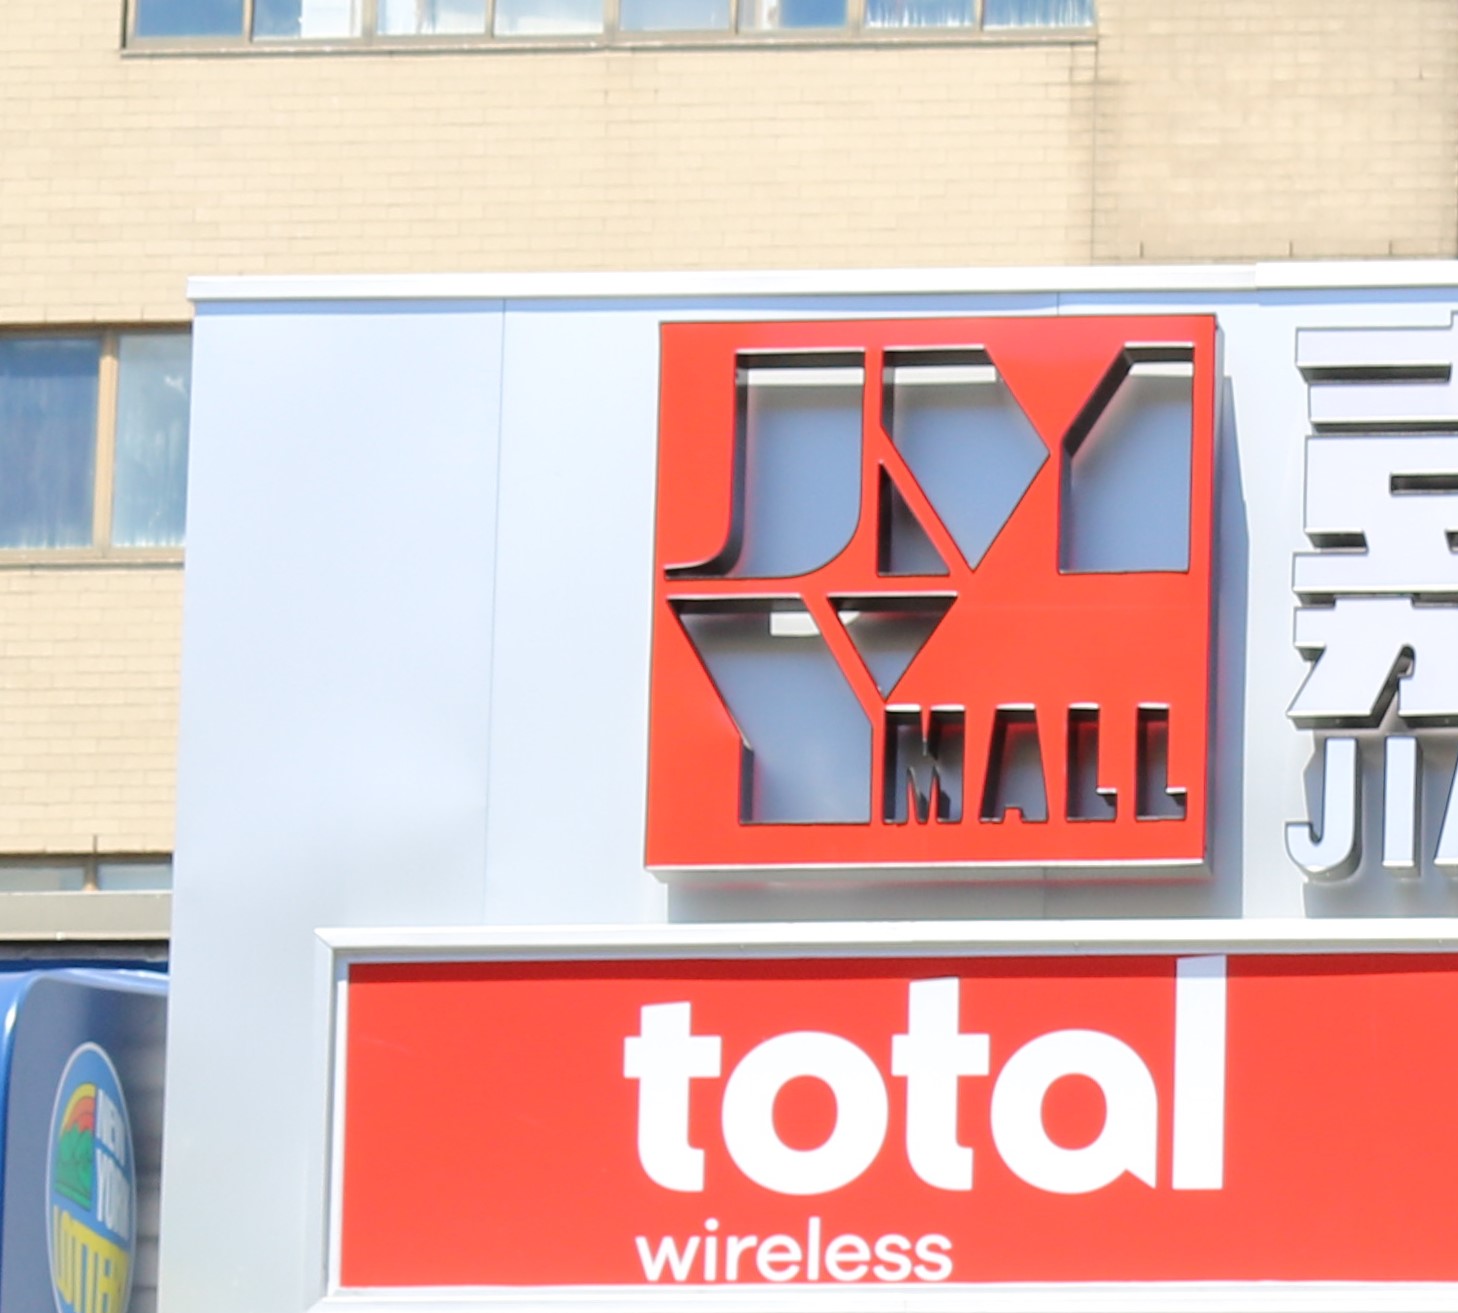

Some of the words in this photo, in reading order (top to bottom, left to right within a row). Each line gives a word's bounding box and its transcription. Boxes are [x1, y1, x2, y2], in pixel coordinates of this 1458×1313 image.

[882, 702, 1187, 825] MALL
[623, 954, 1228, 1196] total
[635, 1216, 953, 1283] wireless
